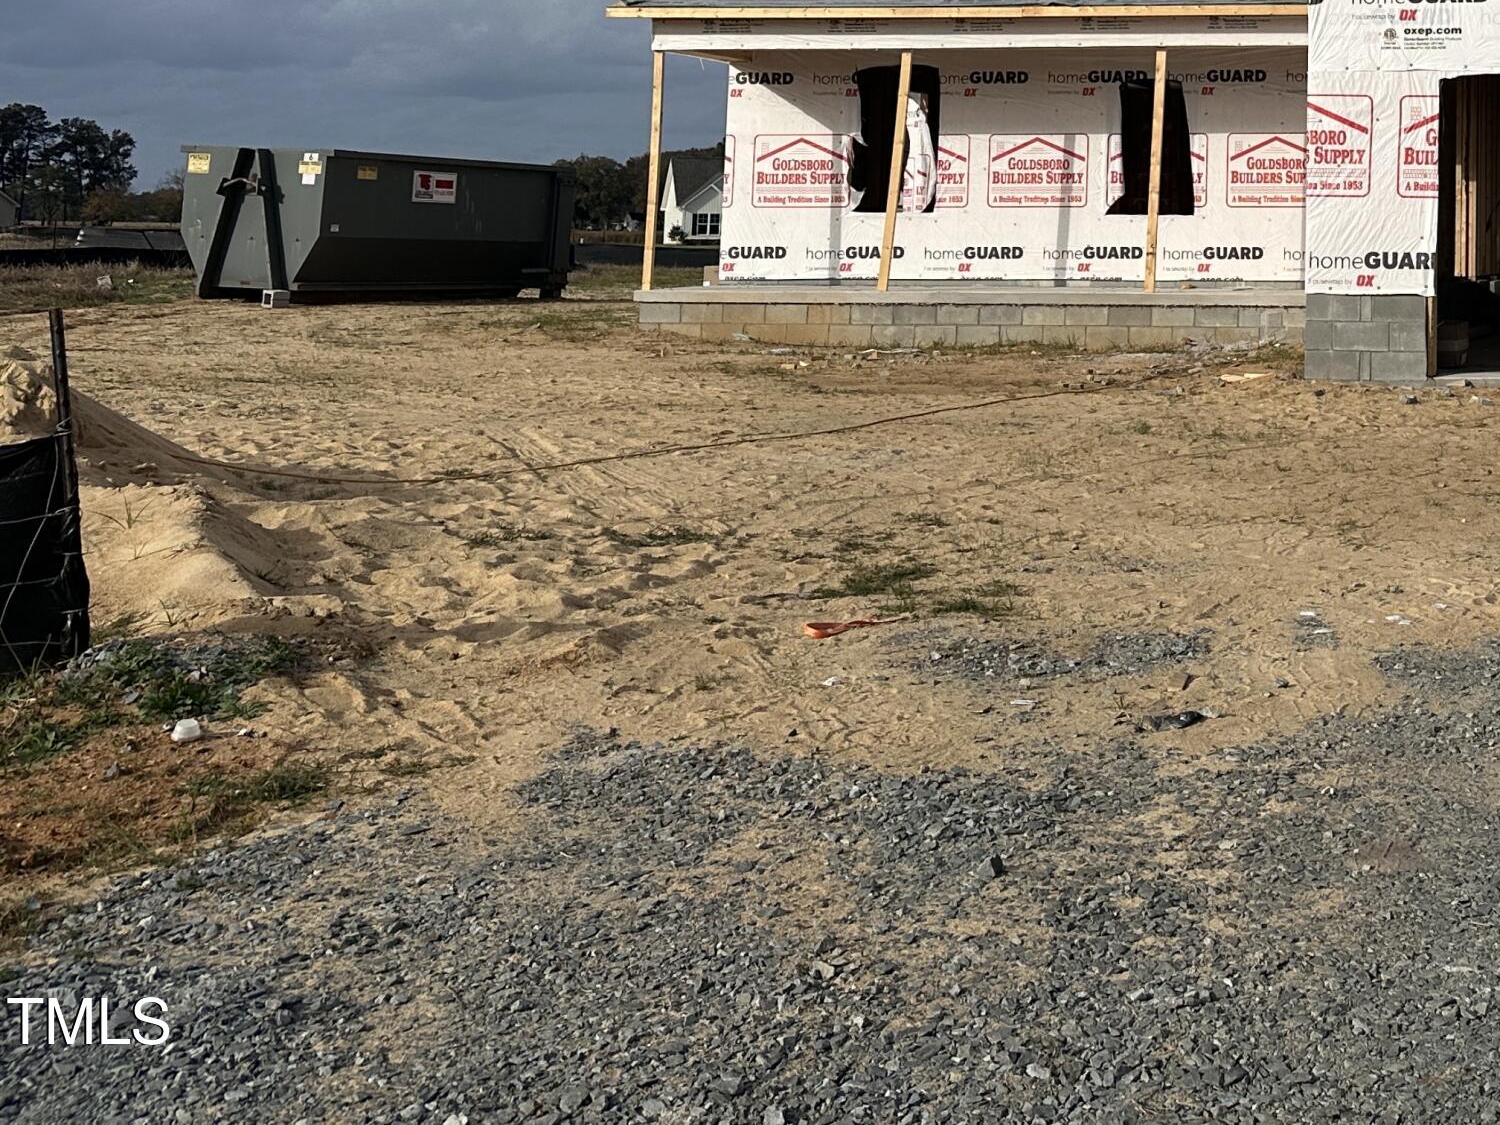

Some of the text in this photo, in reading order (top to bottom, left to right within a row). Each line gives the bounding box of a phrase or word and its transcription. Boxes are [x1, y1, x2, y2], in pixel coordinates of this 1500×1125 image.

[1399, 9, 1418, 21] OX
[1404, 27, 1462, 36] oxep.com
[1048, 71, 1148, 84] homeGUARD
[730, 89, 744, 97] OX
[964, 88, 978, 97] OX
[1082, 87, 1096, 97] OX
[1202, 87, 1215, 96] OX
[1314, 147, 1366, 165] SUPPLY
[772, 157, 834, 171] GOLDSBORO
[1008, 157, 1070, 171] GOLDSBORO
[757, 171, 807, 185] BUILDERS
[992, 171, 1084, 185] BUILDERS SUPPLY
[1231, 171, 1282, 183] BUILDERS
[1342, 180, 1364, 191] 1953
[1405, 182, 1412, 191] A
[806, 246, 905, 259] homeGUAD
[924, 246, 1024, 259] homeGUARD
[1043, 246, 1143, 259] homeGUARD
[1163, 246, 1264, 259] homeGUARD
[722, 263, 736, 272] OX
[840, 263, 853, 272] OX
[958, 263, 972, 272] OX
[1077, 263, 1092, 273] OX
[1197, 263, 1211, 273] OX
[1356, 275, 1375, 287] OX
